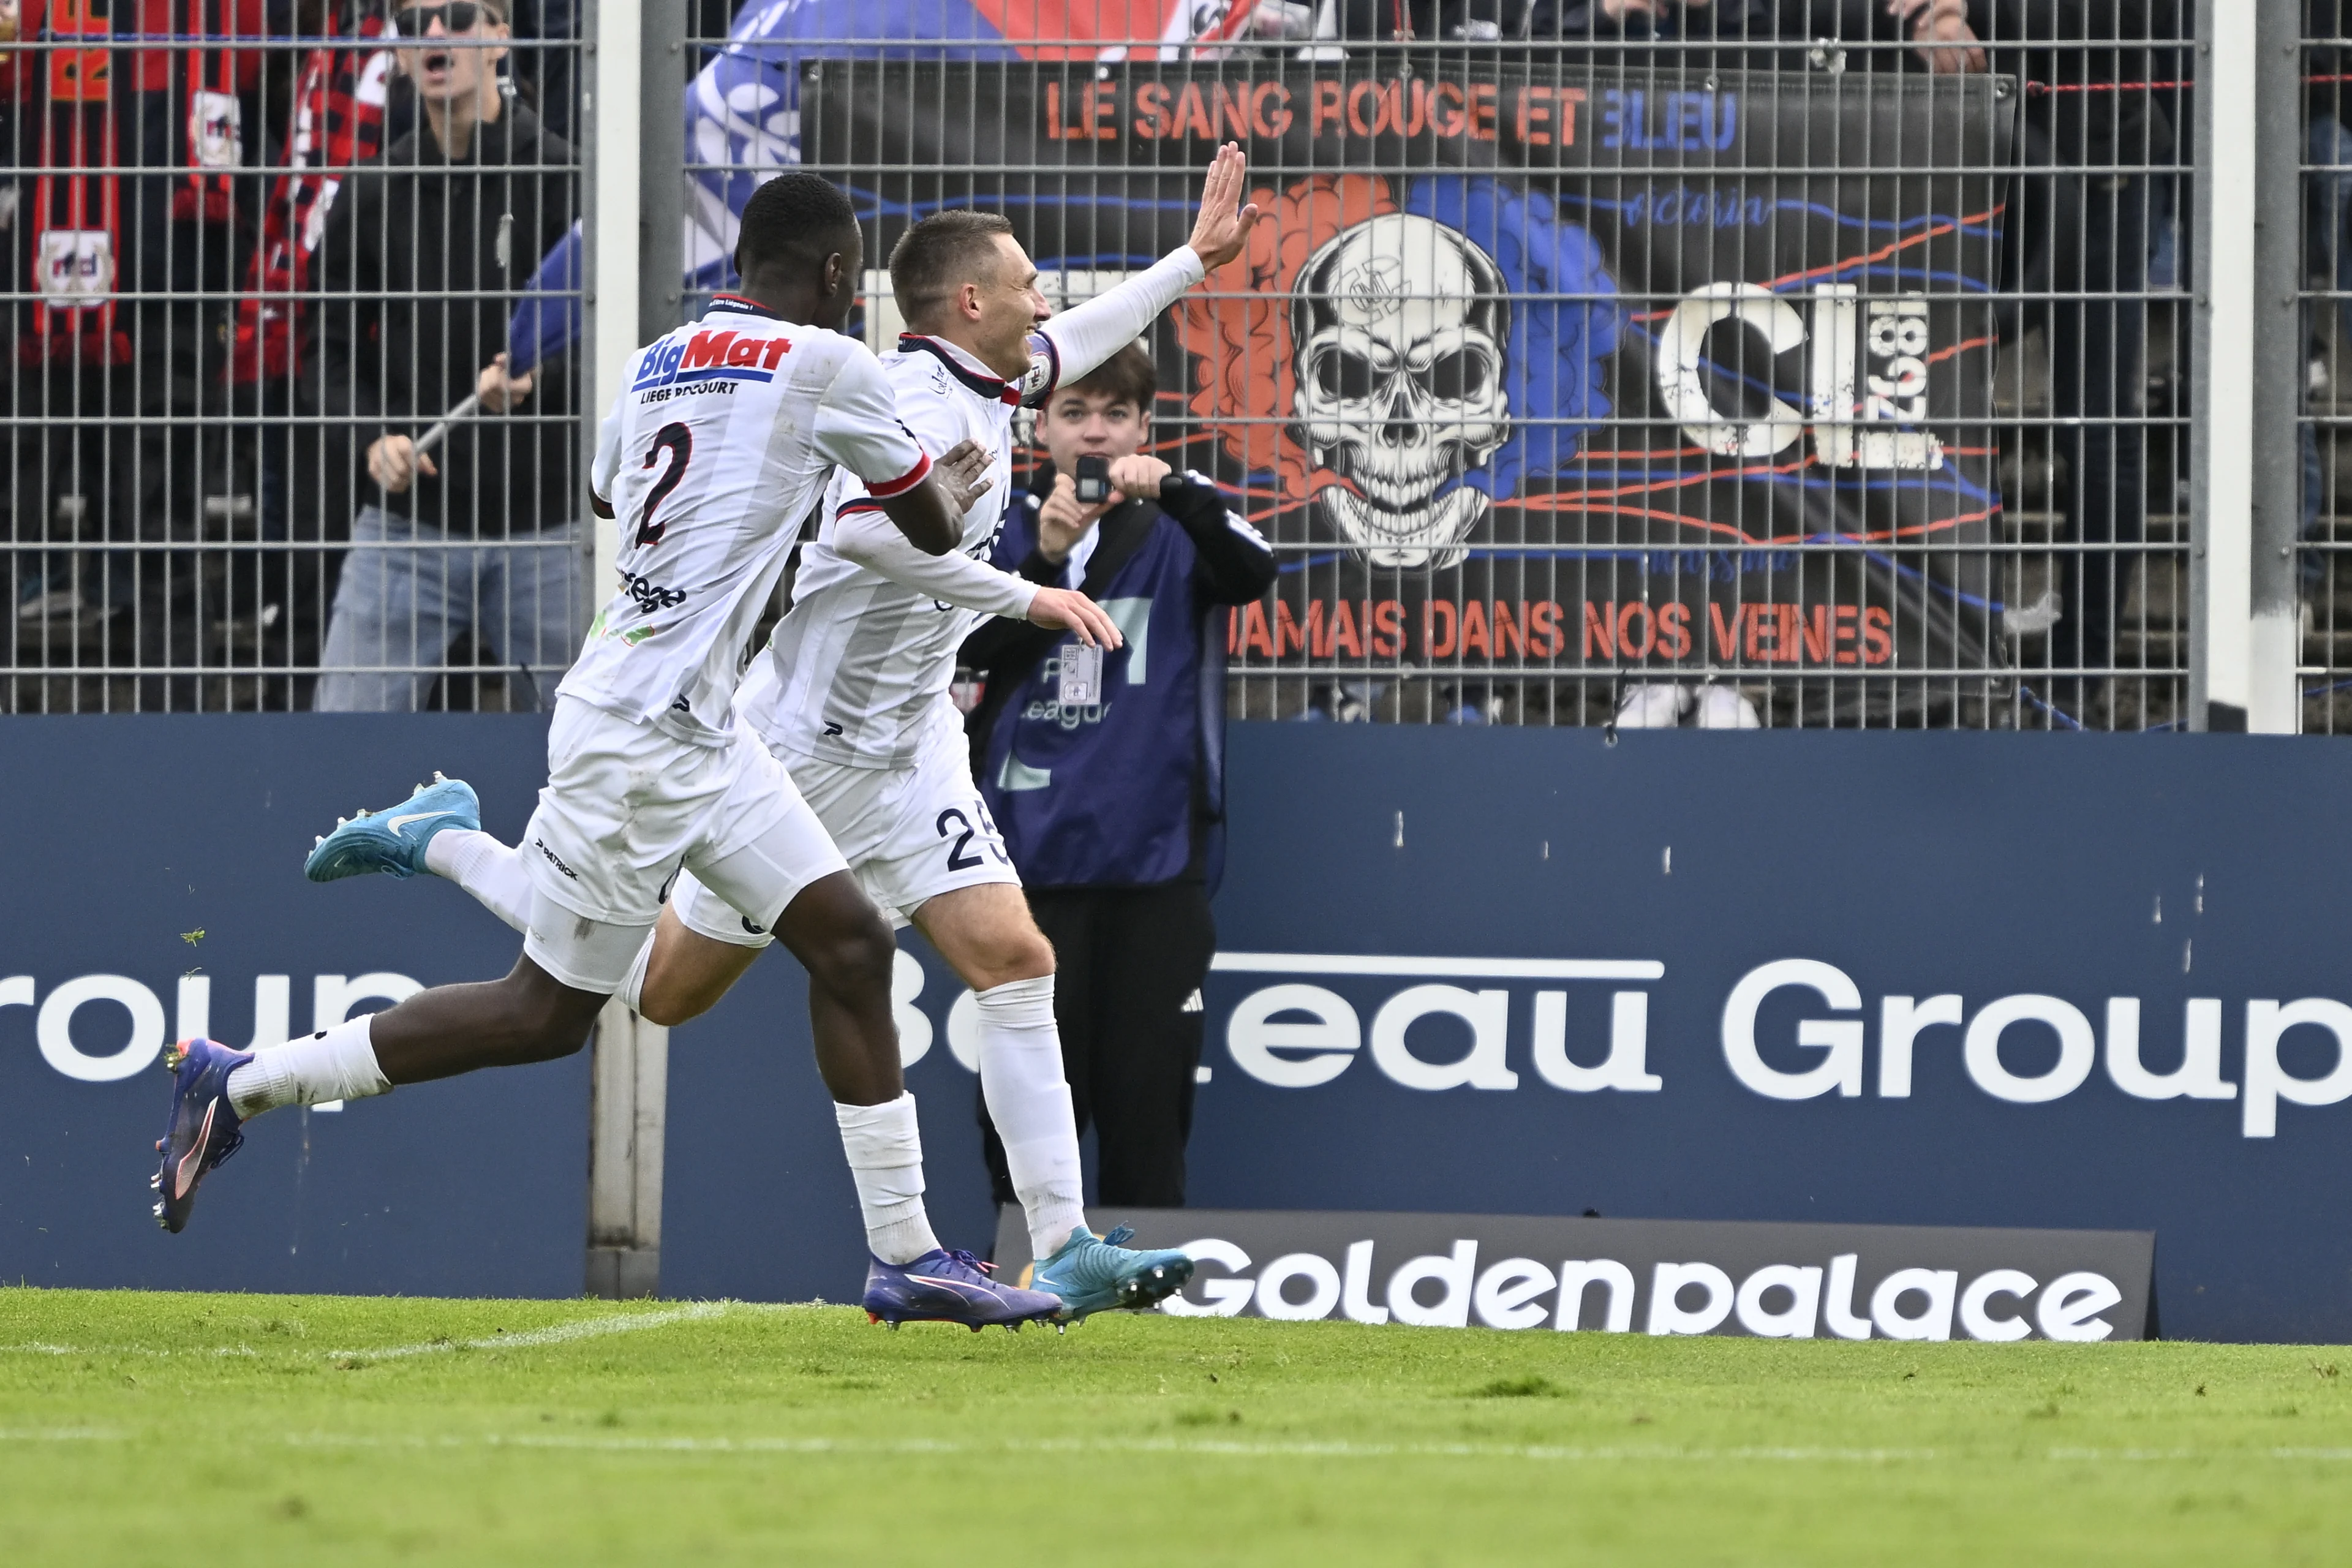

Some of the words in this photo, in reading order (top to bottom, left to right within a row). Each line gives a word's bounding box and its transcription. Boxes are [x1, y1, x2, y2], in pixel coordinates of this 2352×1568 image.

[1047, 82, 1117, 139] LE
[1136, 81, 1293, 139] SANG
[1313, 78, 1497, 138] ROUGE
[1515, 86, 1586, 146] ET
[635, 330, 793, 385] BigMat
[1869, 290, 1928, 424] 1892
[640, 388, 672, 404] LIEGE
[635, 421, 693, 549] 2
[1423, 600, 1566, 658] DANS
[1585, 601, 1692, 659] NOS
[1709, 602, 1892, 665] VEINES
[1020, 700, 1112, 729] eagu
[543, 847, 578, 881] PATRICK
[1721, 958, 2352, 1138] Group
[1161, 1238, 2123, 1343] Goldenpalace
